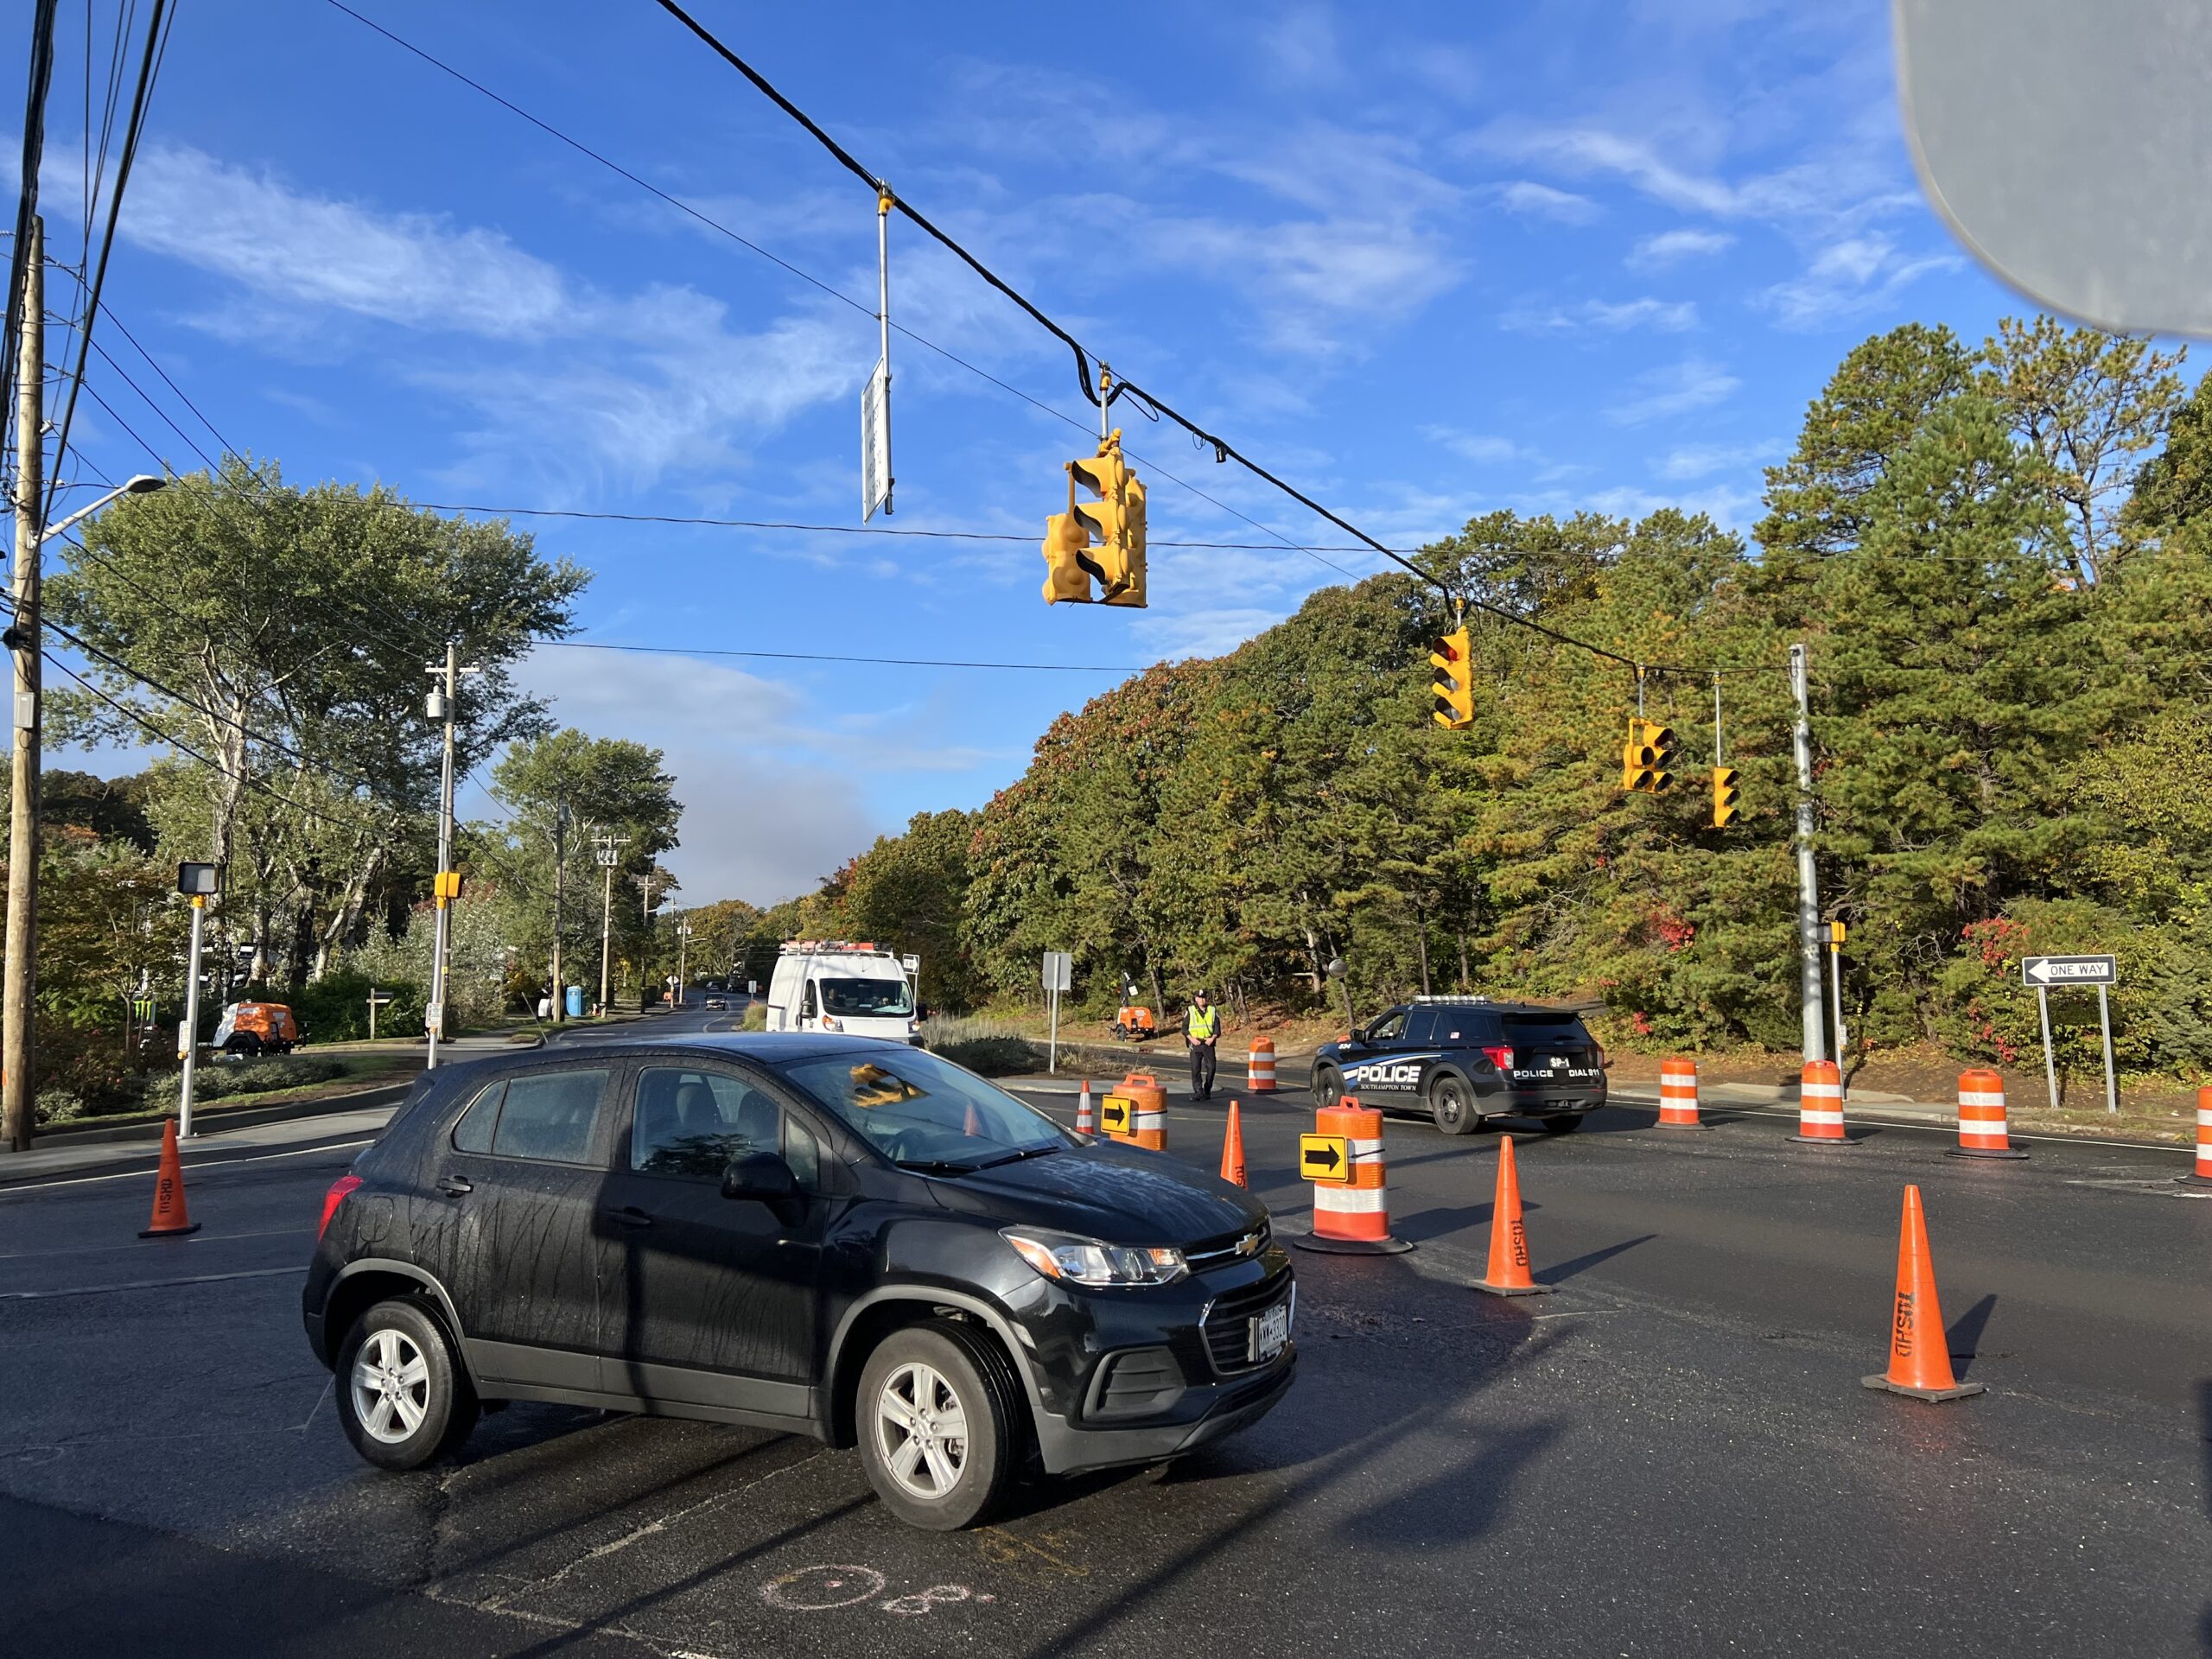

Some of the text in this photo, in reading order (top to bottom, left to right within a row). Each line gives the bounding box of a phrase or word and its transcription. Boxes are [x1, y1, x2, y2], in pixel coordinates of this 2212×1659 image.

[2050, 964, 2104, 976] ONE WAY
[1550, 1057, 1570, 1068] SP-1
[1357, 1065, 1422, 1083] POLICE
[1513, 1070, 1554, 1078] POLICE
[1568, 1068, 1600, 1077] DIAL 911
